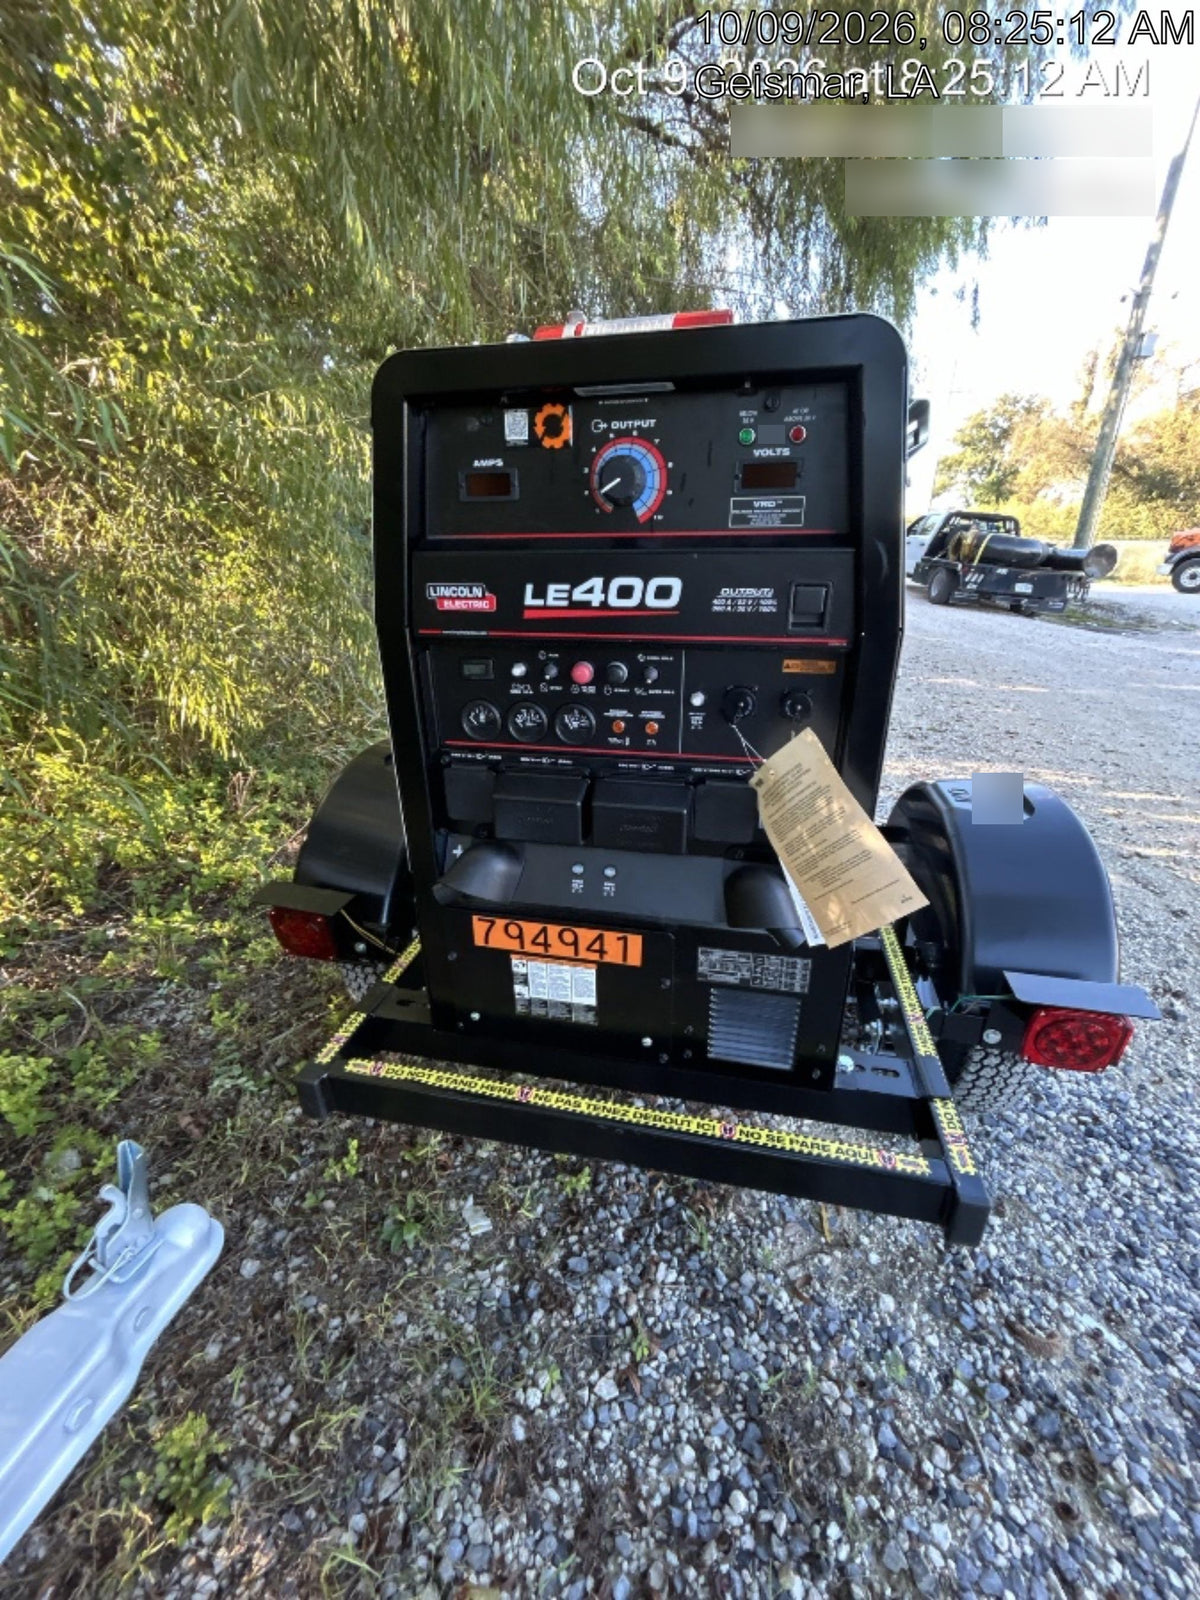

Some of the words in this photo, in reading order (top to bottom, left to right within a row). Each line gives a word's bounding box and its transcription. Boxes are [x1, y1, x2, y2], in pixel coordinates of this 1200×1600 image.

[611, 419, 657, 430] OUTPUT
[753, 447, 791, 457] VOLTS
[472, 458, 504, 467] AMPS
[429, 585, 483, 598] LINCOLN
[523, 576, 683, 608] LE400
[443, 600, 490, 610] ELECTRIC
[477, 917, 629, 963] 794941
[406, 1070, 433, 1080] NOT
[435, 1074, 477, 1089] STAND
[554, 1096, 582, 1109] PAS
[696, 1122, 716, 1132] ICI
[738, 1129, 762, 1141] NO
[765, 1134, 786, 1145] SE
[788, 1137, 831, 1154] PARE
